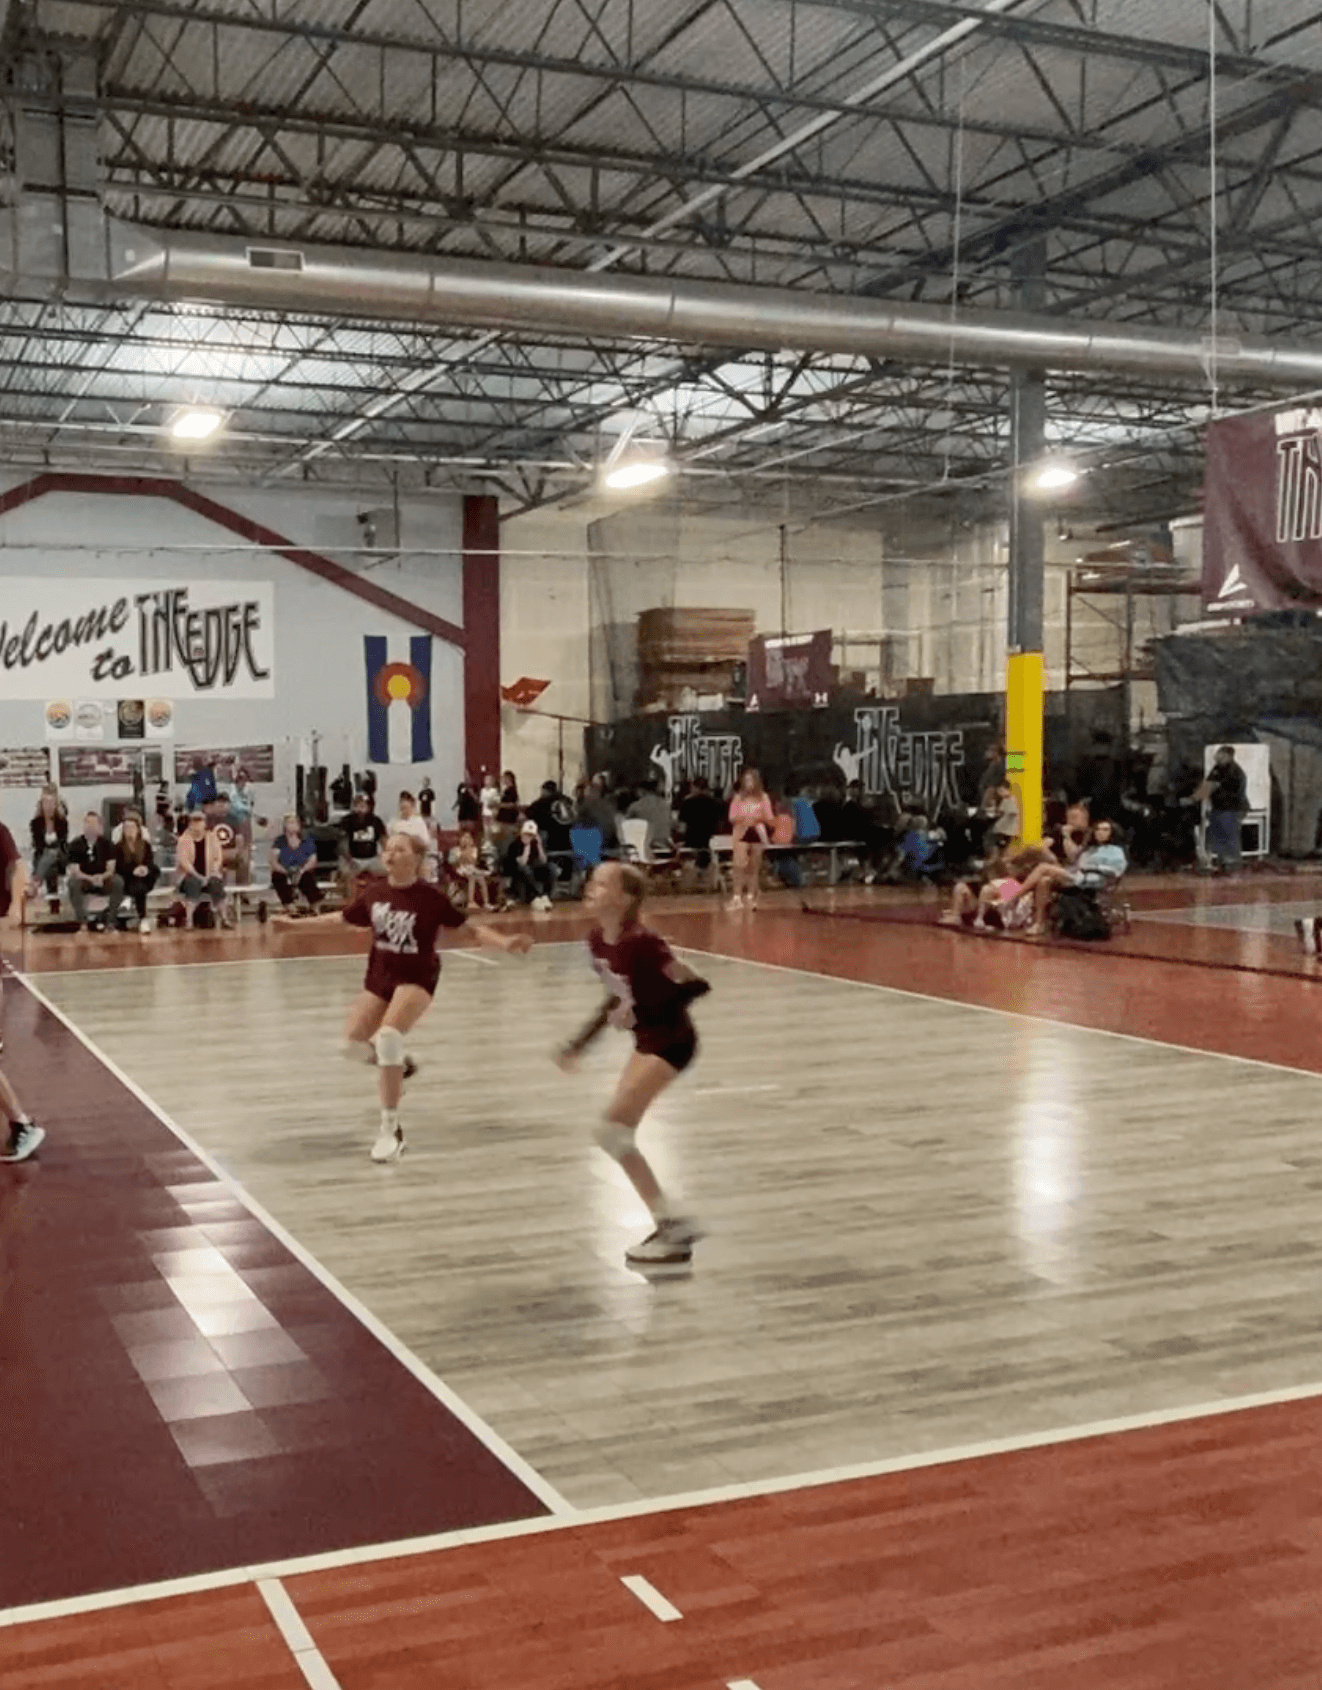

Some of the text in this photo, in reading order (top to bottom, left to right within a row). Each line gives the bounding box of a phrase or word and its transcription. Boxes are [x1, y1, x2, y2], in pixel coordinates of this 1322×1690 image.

[90, 647, 135, 681] to
[134, 586, 200, 677] THE
[185, 600, 271, 691] EDGE
